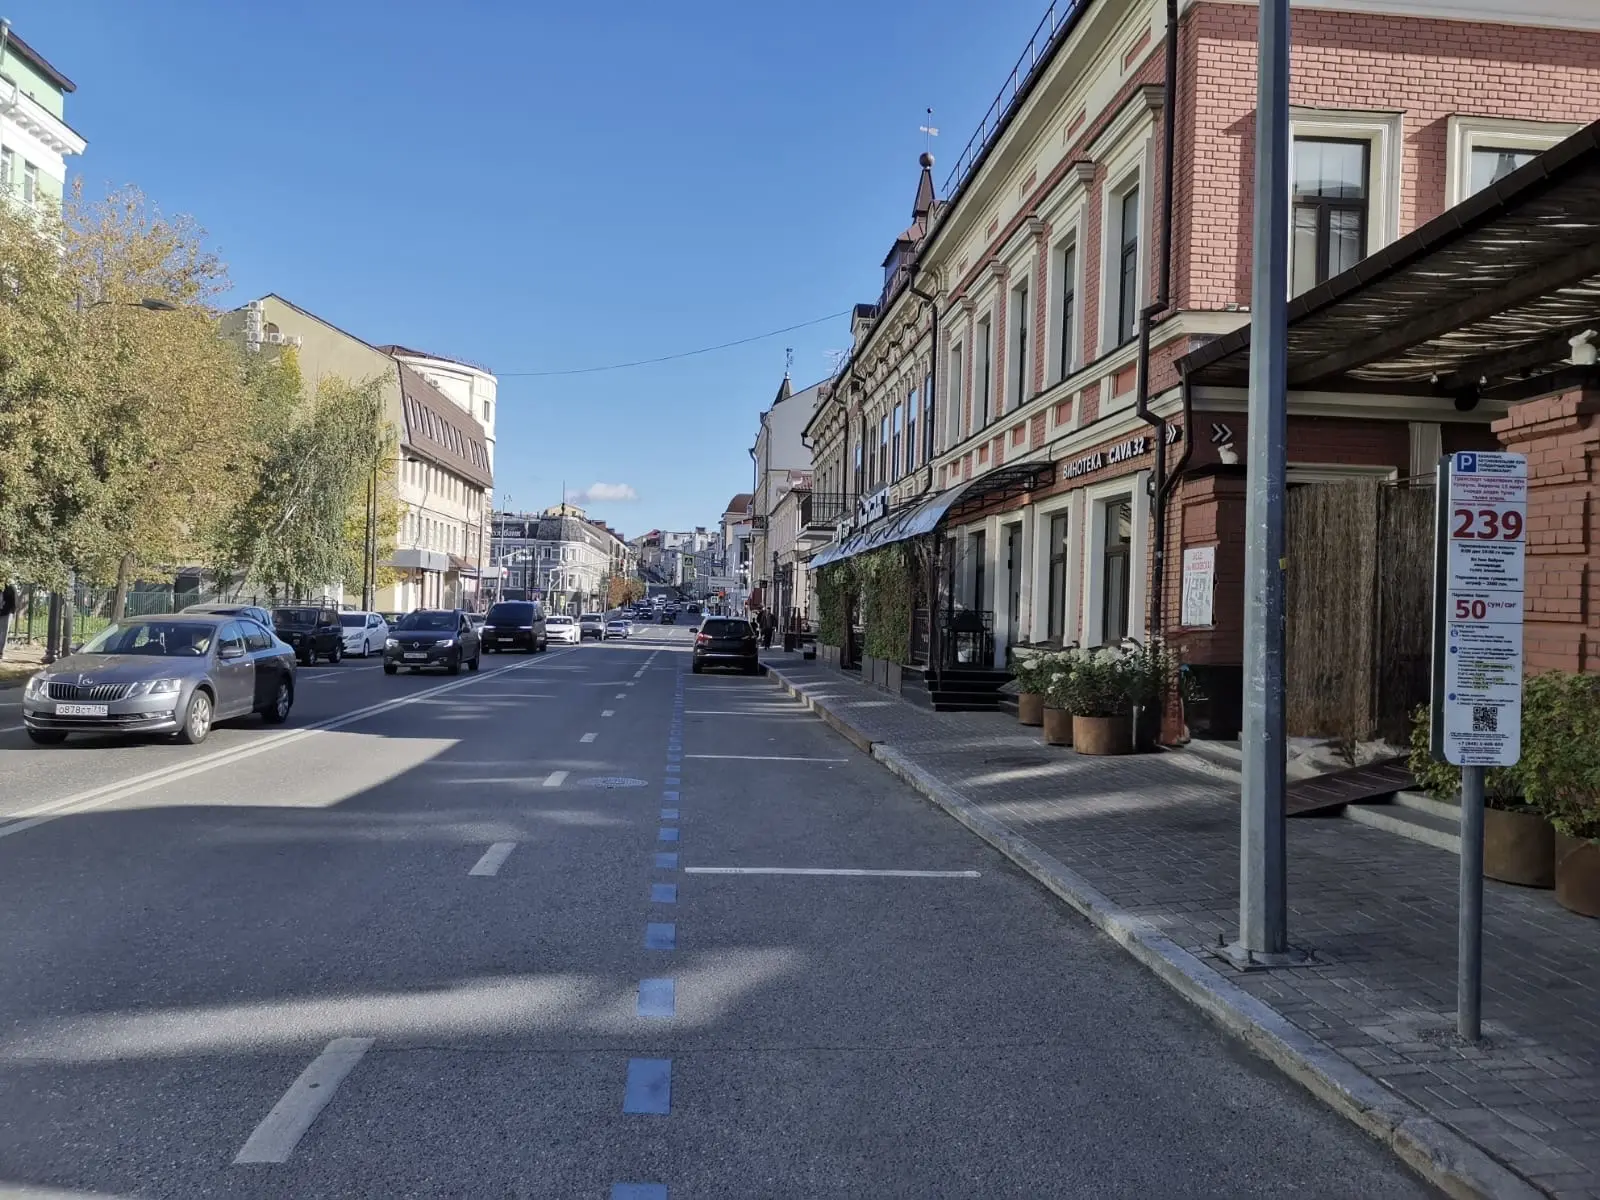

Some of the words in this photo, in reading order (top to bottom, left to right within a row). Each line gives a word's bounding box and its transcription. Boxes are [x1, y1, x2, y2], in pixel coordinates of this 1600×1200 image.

[1063, 453, 1102, 479] ВИНОТЕКА
[1109, 441, 1132, 464] CAVA
[1133, 437, 1145, 455] 32
[1454, 509, 1523, 540] 239
[1456, 600, 1486, 619] 50
